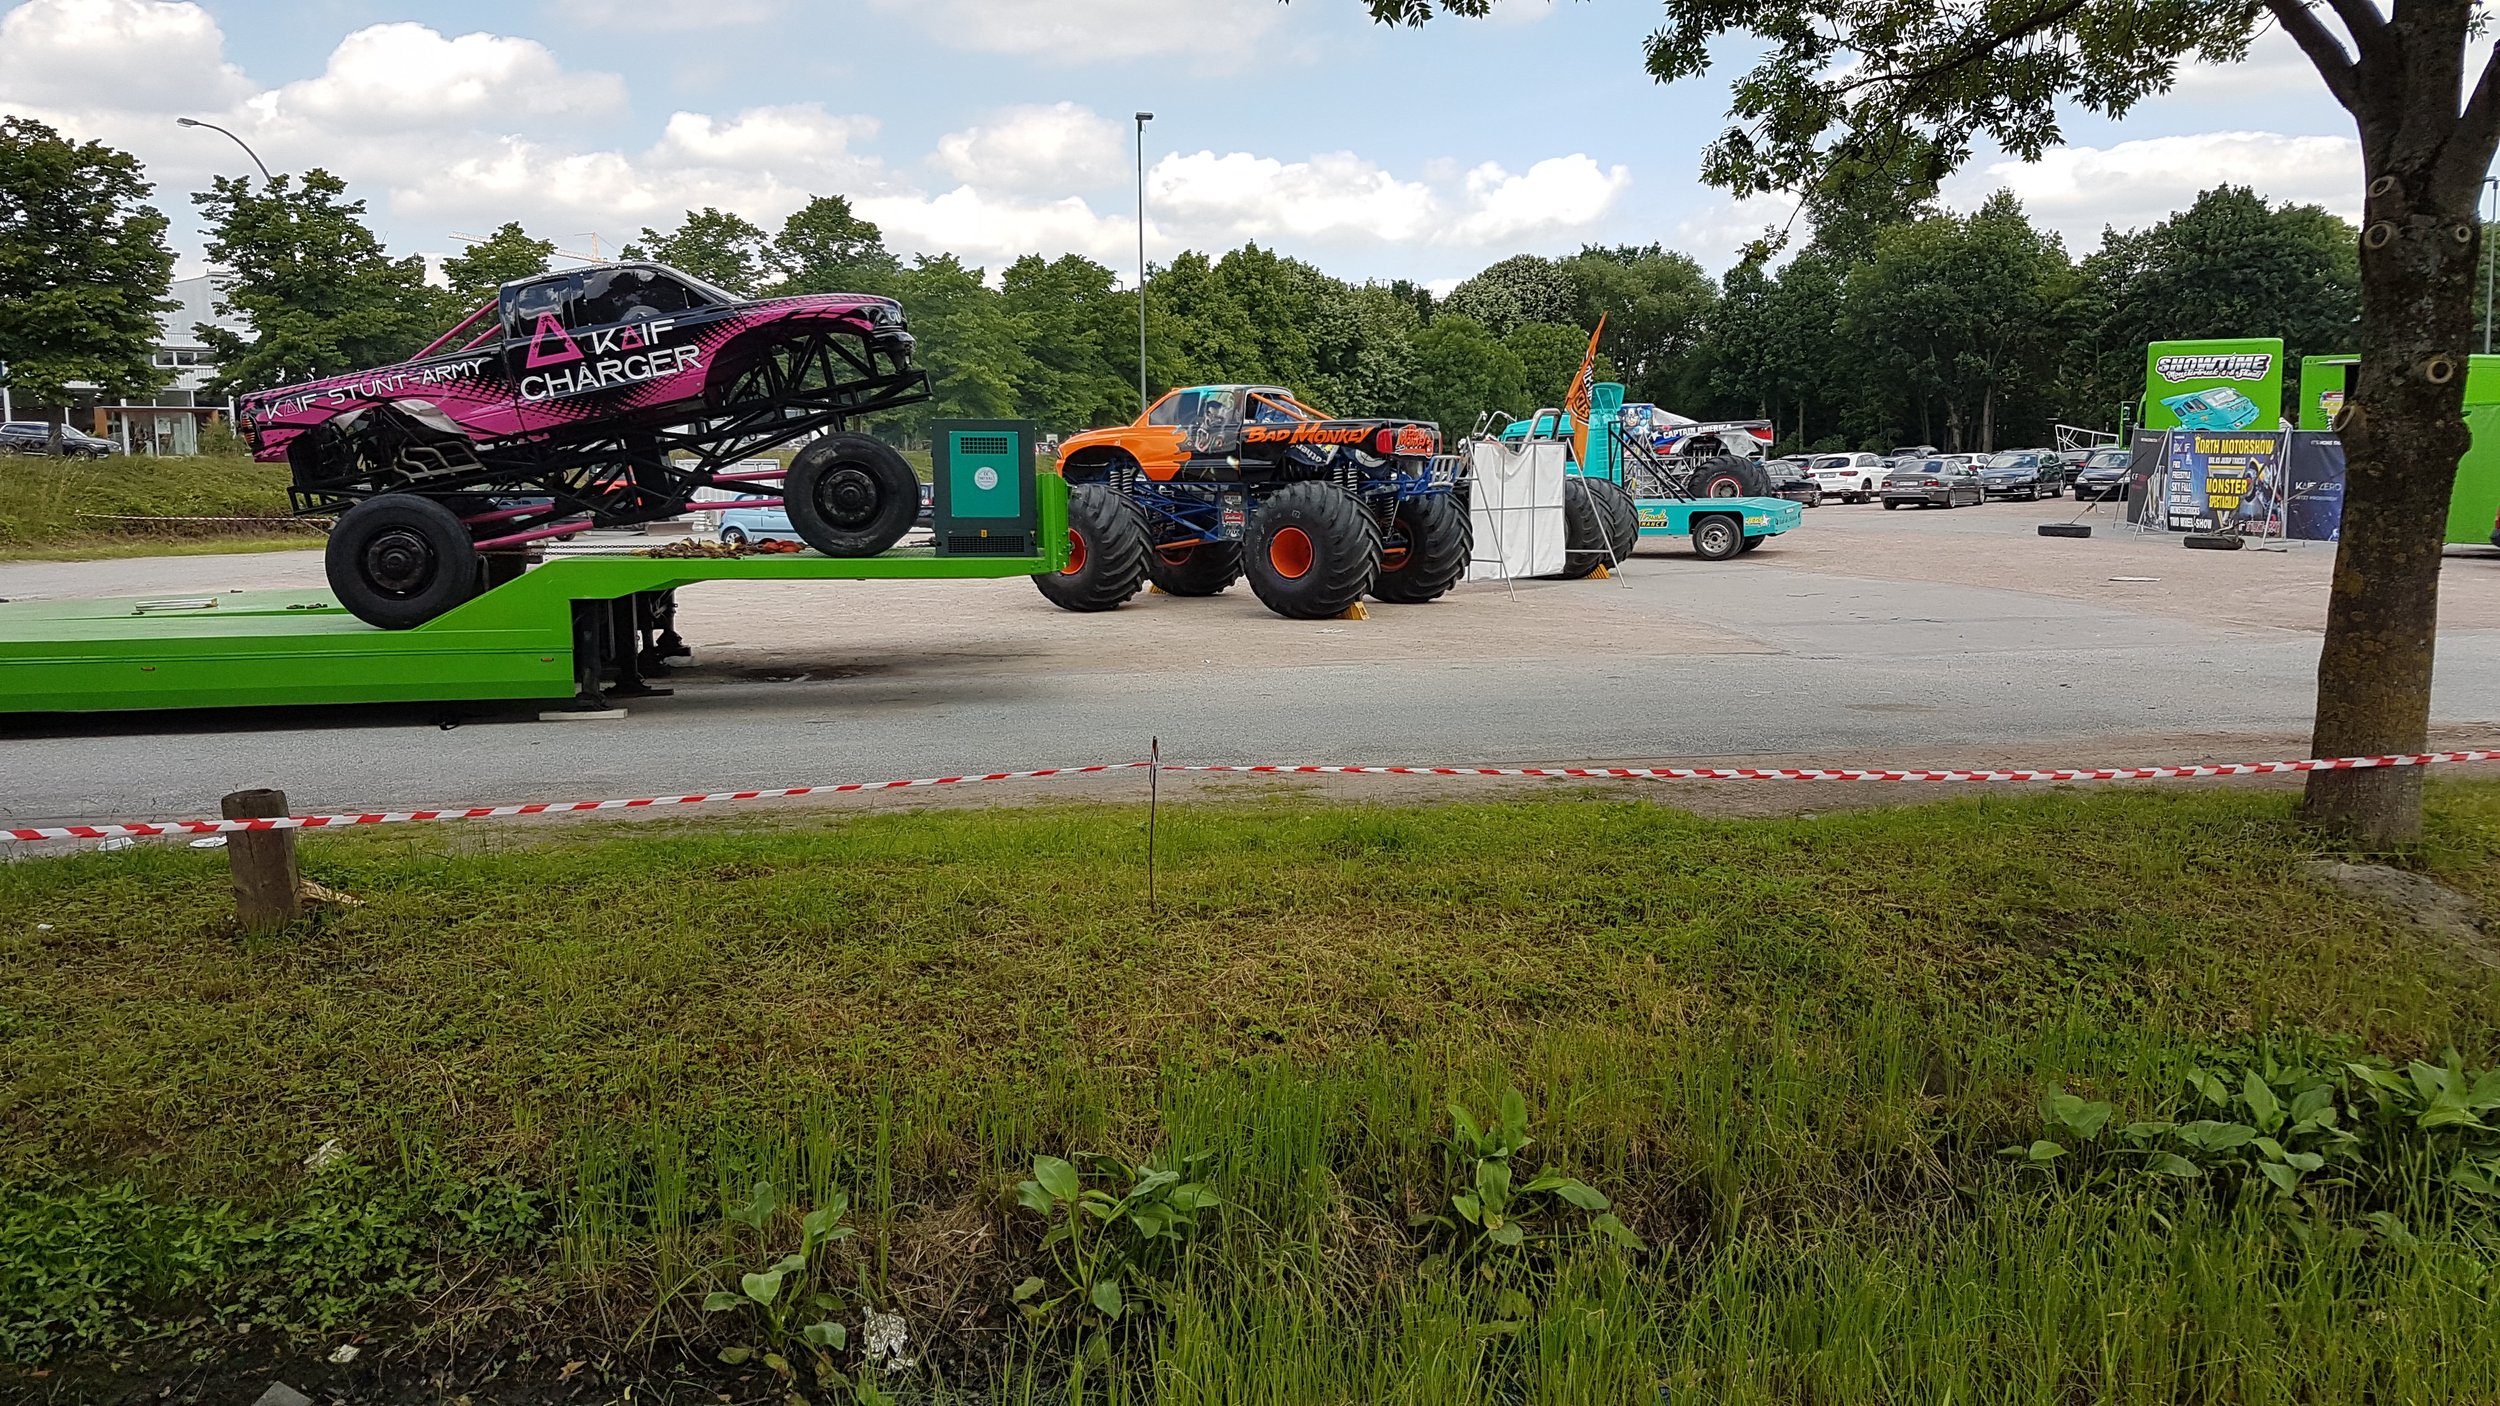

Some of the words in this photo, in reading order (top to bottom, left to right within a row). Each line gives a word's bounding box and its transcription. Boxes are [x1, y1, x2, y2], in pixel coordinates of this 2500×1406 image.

[592, 318, 676, 355] KAIF
[520, 344, 704, 400] CHARGER
[2158, 355, 2268, 372] SHOWTIME
[264, 393, 317, 420] KAIF
[328, 358, 484, 405] STUNT-ARMY
[1241, 425, 1291, 443] BAD
[1288, 422, 1376, 444] MONKEY
[1662, 427, 1697, 439] CAPTAIN
[1697, 423, 1732, 434] AMERICA
[2220, 439, 2275, 455] MOTORSHOW
[2206, 478, 2248, 494] MONSTER
